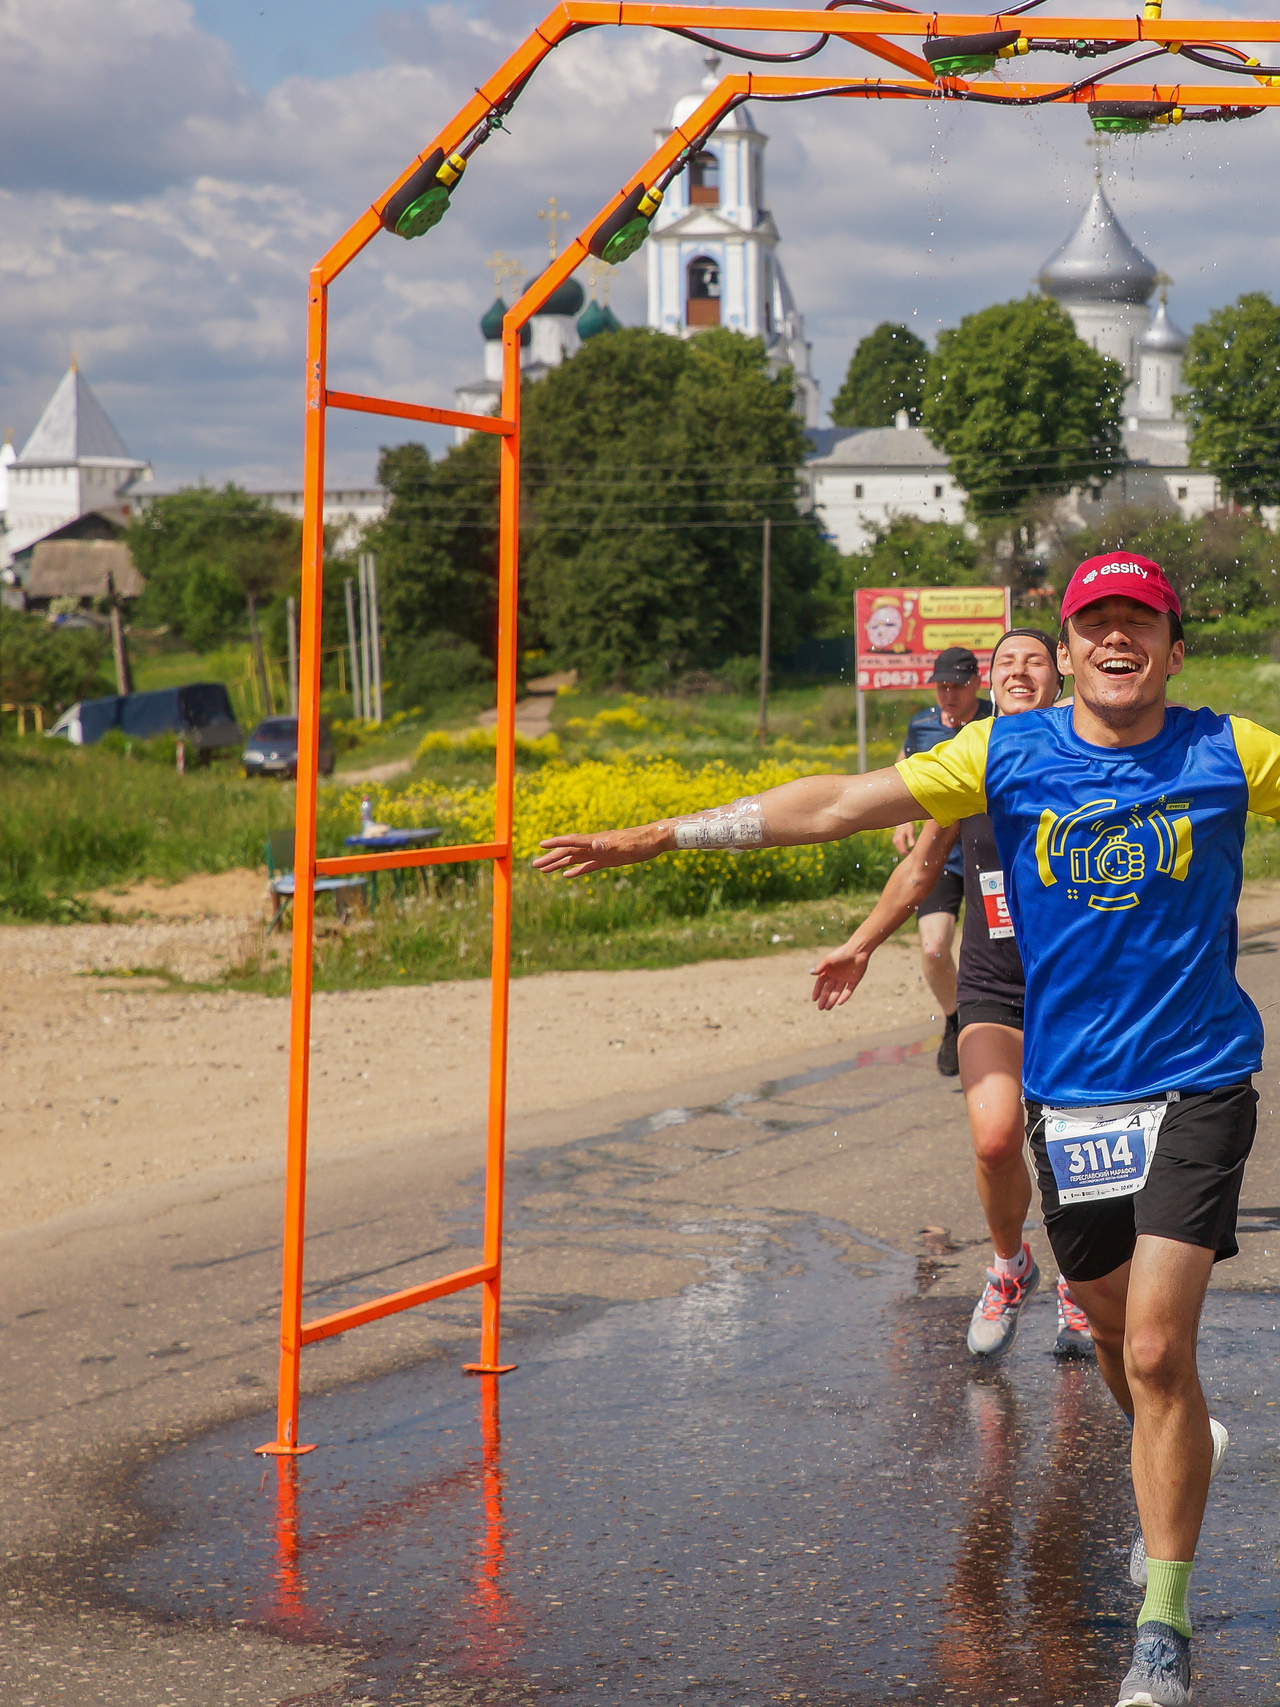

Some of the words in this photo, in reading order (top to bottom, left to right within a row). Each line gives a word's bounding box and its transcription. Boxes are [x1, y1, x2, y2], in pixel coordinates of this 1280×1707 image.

[1100, 562, 1147, 579] essity
[1063, 1135, 1133, 1174] 3114
[1070, 1170, 1109, 1182] ПЕРЕСЛАВСКИЙ
[1110, 1166, 1136, 1176] МАРАФОН
